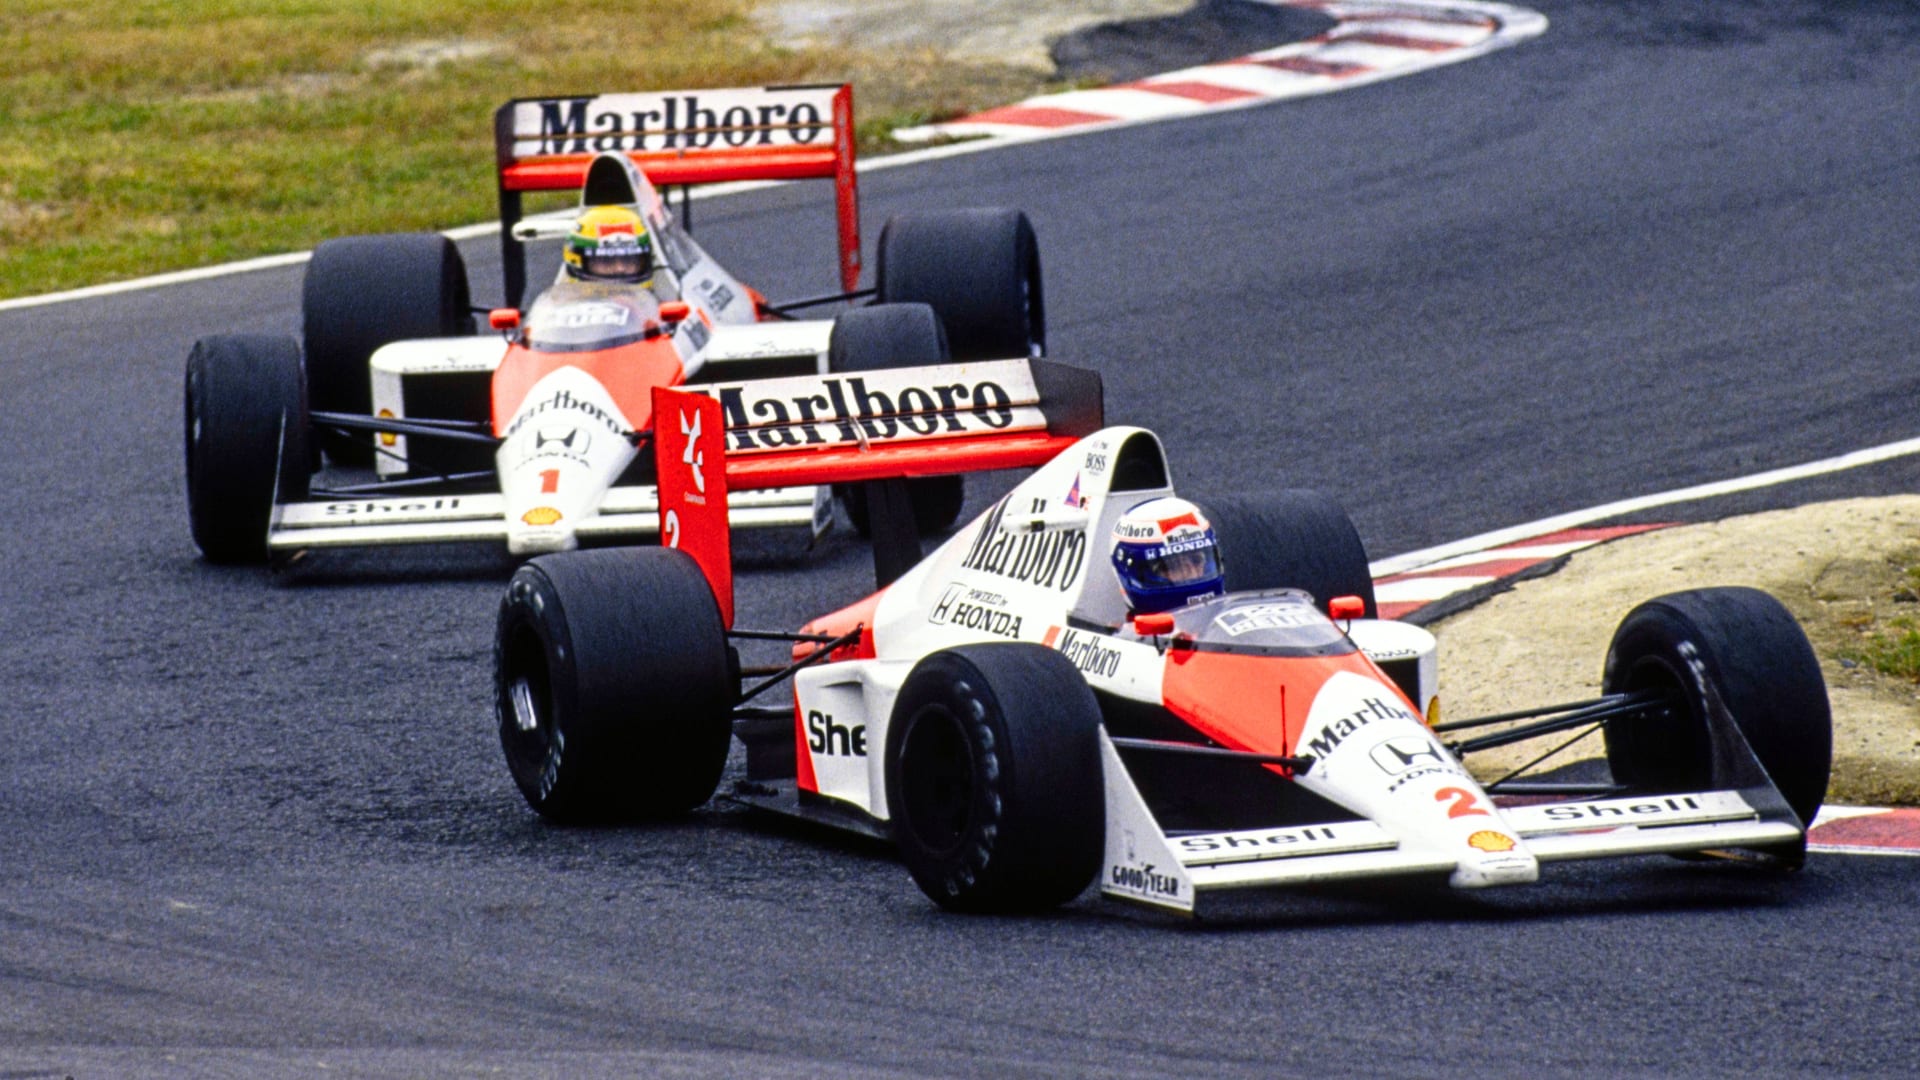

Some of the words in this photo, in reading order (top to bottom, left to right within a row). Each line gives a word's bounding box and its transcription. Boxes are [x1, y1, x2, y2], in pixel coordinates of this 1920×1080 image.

[538, 97, 822, 155] Marlboro
[1085, 452, 1106, 472] BOSS
[539, 468, 560, 494] 1
[326, 499, 460, 515] Shell
[1159, 539, 1213, 557] HONDA
[951, 602, 1023, 640] HONDA
[1061, 629, 1122, 678] Marlboro
[808, 709, 868, 757] She
[1434, 786, 1491, 820] 2
[1545, 797, 1700, 822] Shell
[1181, 827, 1337, 852] Shell
